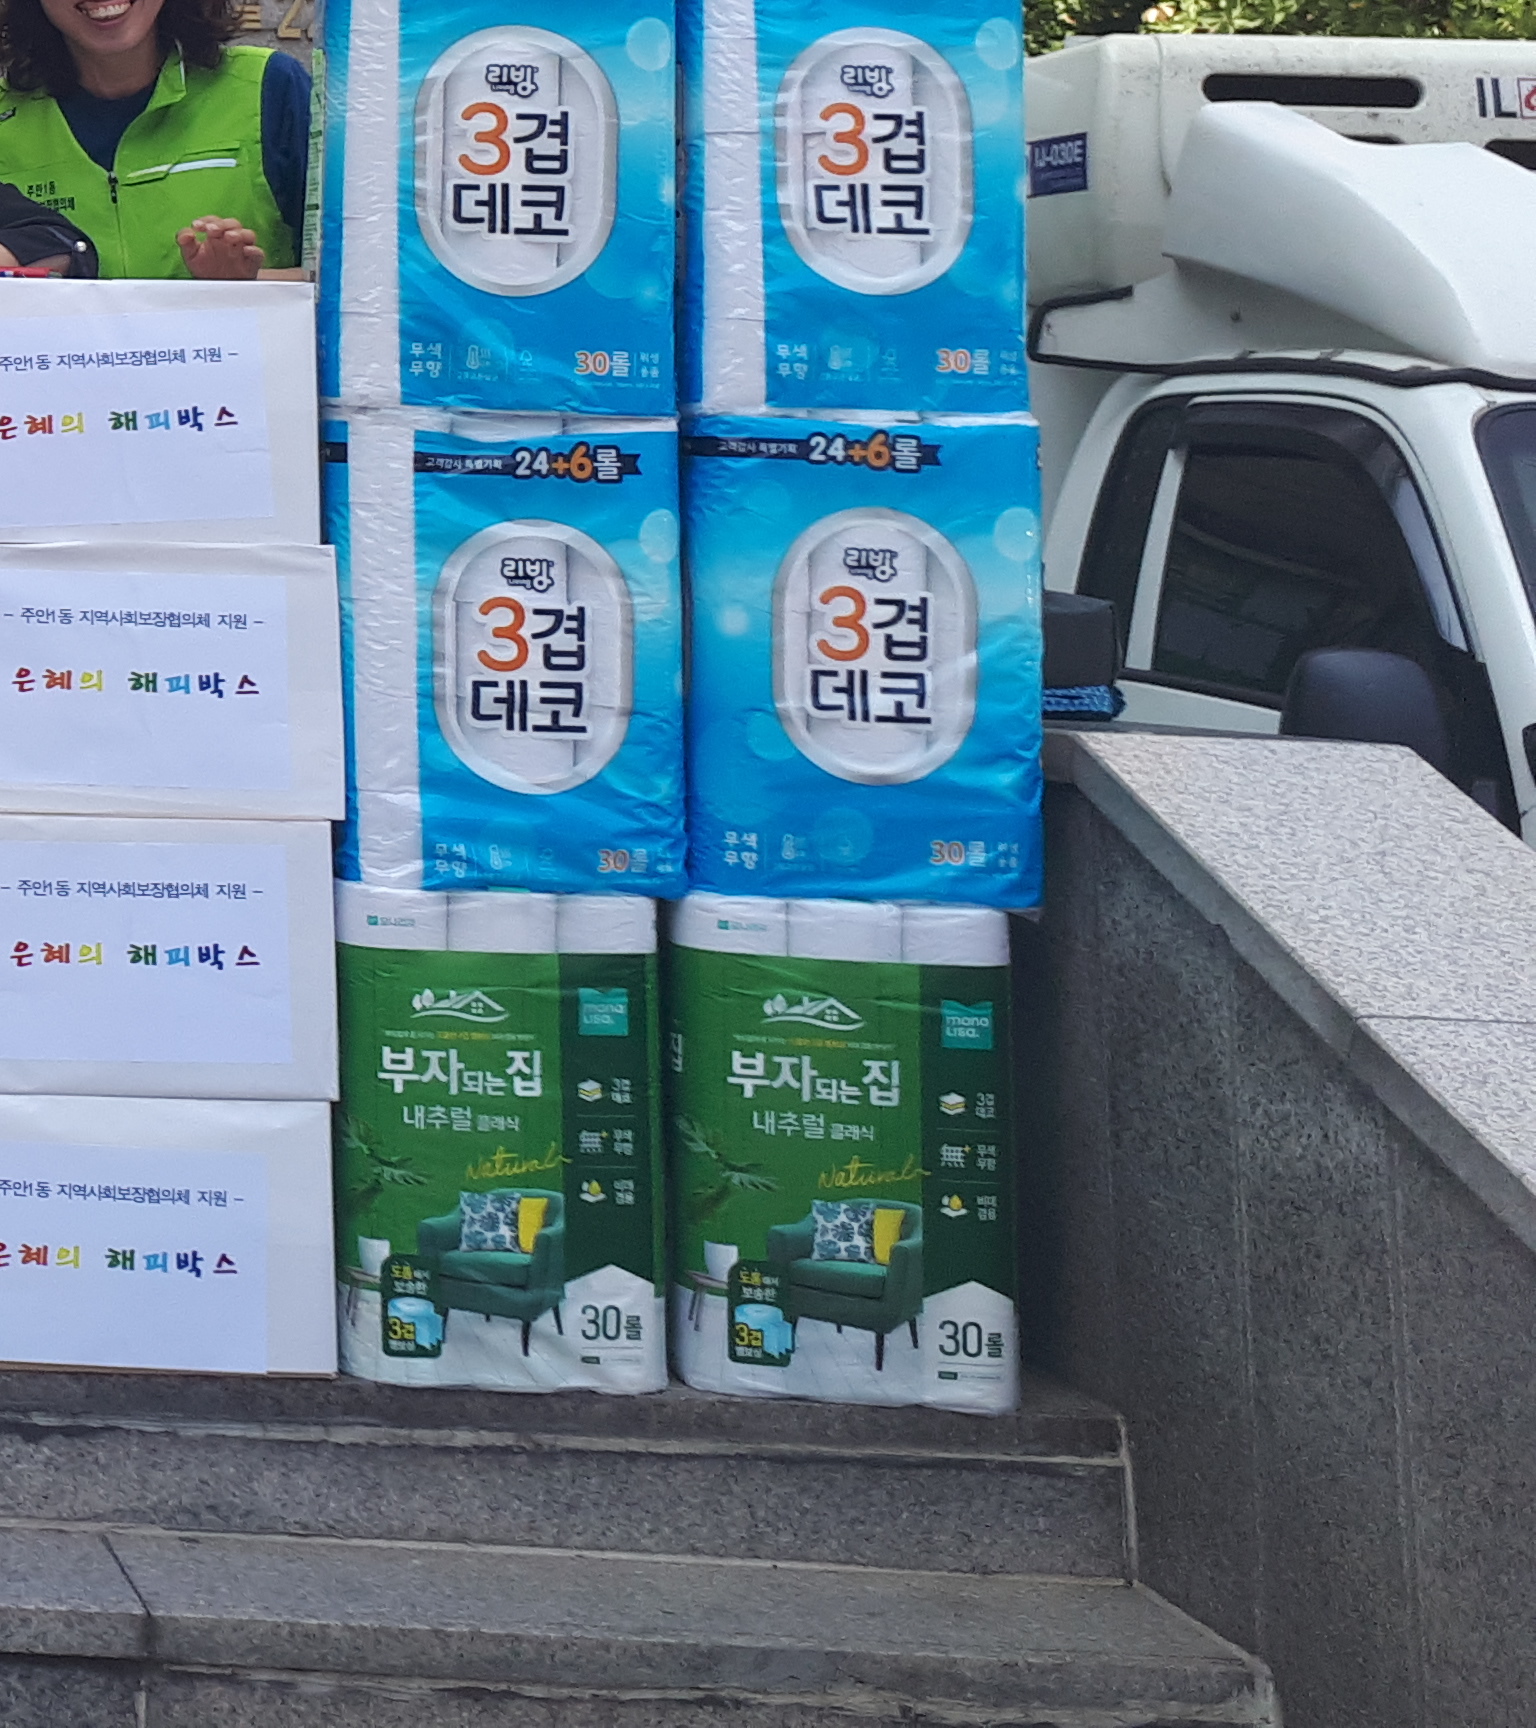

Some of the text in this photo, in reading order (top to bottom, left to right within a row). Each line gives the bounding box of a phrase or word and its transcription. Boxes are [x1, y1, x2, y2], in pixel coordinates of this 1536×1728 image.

[486, 63, 539, 98] 리빙
[841, 64, 893, 98] 리빙
[458, 101, 570, 177] 3겹
[818, 102, 926, 176] 3겹
[452, 183, 569, 236] 데코
[815, 181, 930, 236] 데코
[575, 350, 631, 378] 30롤
[935, 347, 990, 374] 30롤
[808, 432, 922, 471] 24+6롤
[844, 548, 897, 581] 리빙
[816, 585, 929, 662] 3겹
[810, 668, 933, 724] 데코
[17, 879, 247, 900] 주안1동 지역사회보장협의체 지원
[9, 940, 261, 971] 은혜의 해피박스
[402, 1104, 473, 1133] 내추럴
[752, 1110, 875, 1141] 내추럴 클래식
[56, 1182, 191, 1206] 지역사회보장협의체
[197, 1189, 227, 1208] 지원
[104, 1247, 238, 1279] 해피박스
[938, 1319, 1005, 1359] 30롤
